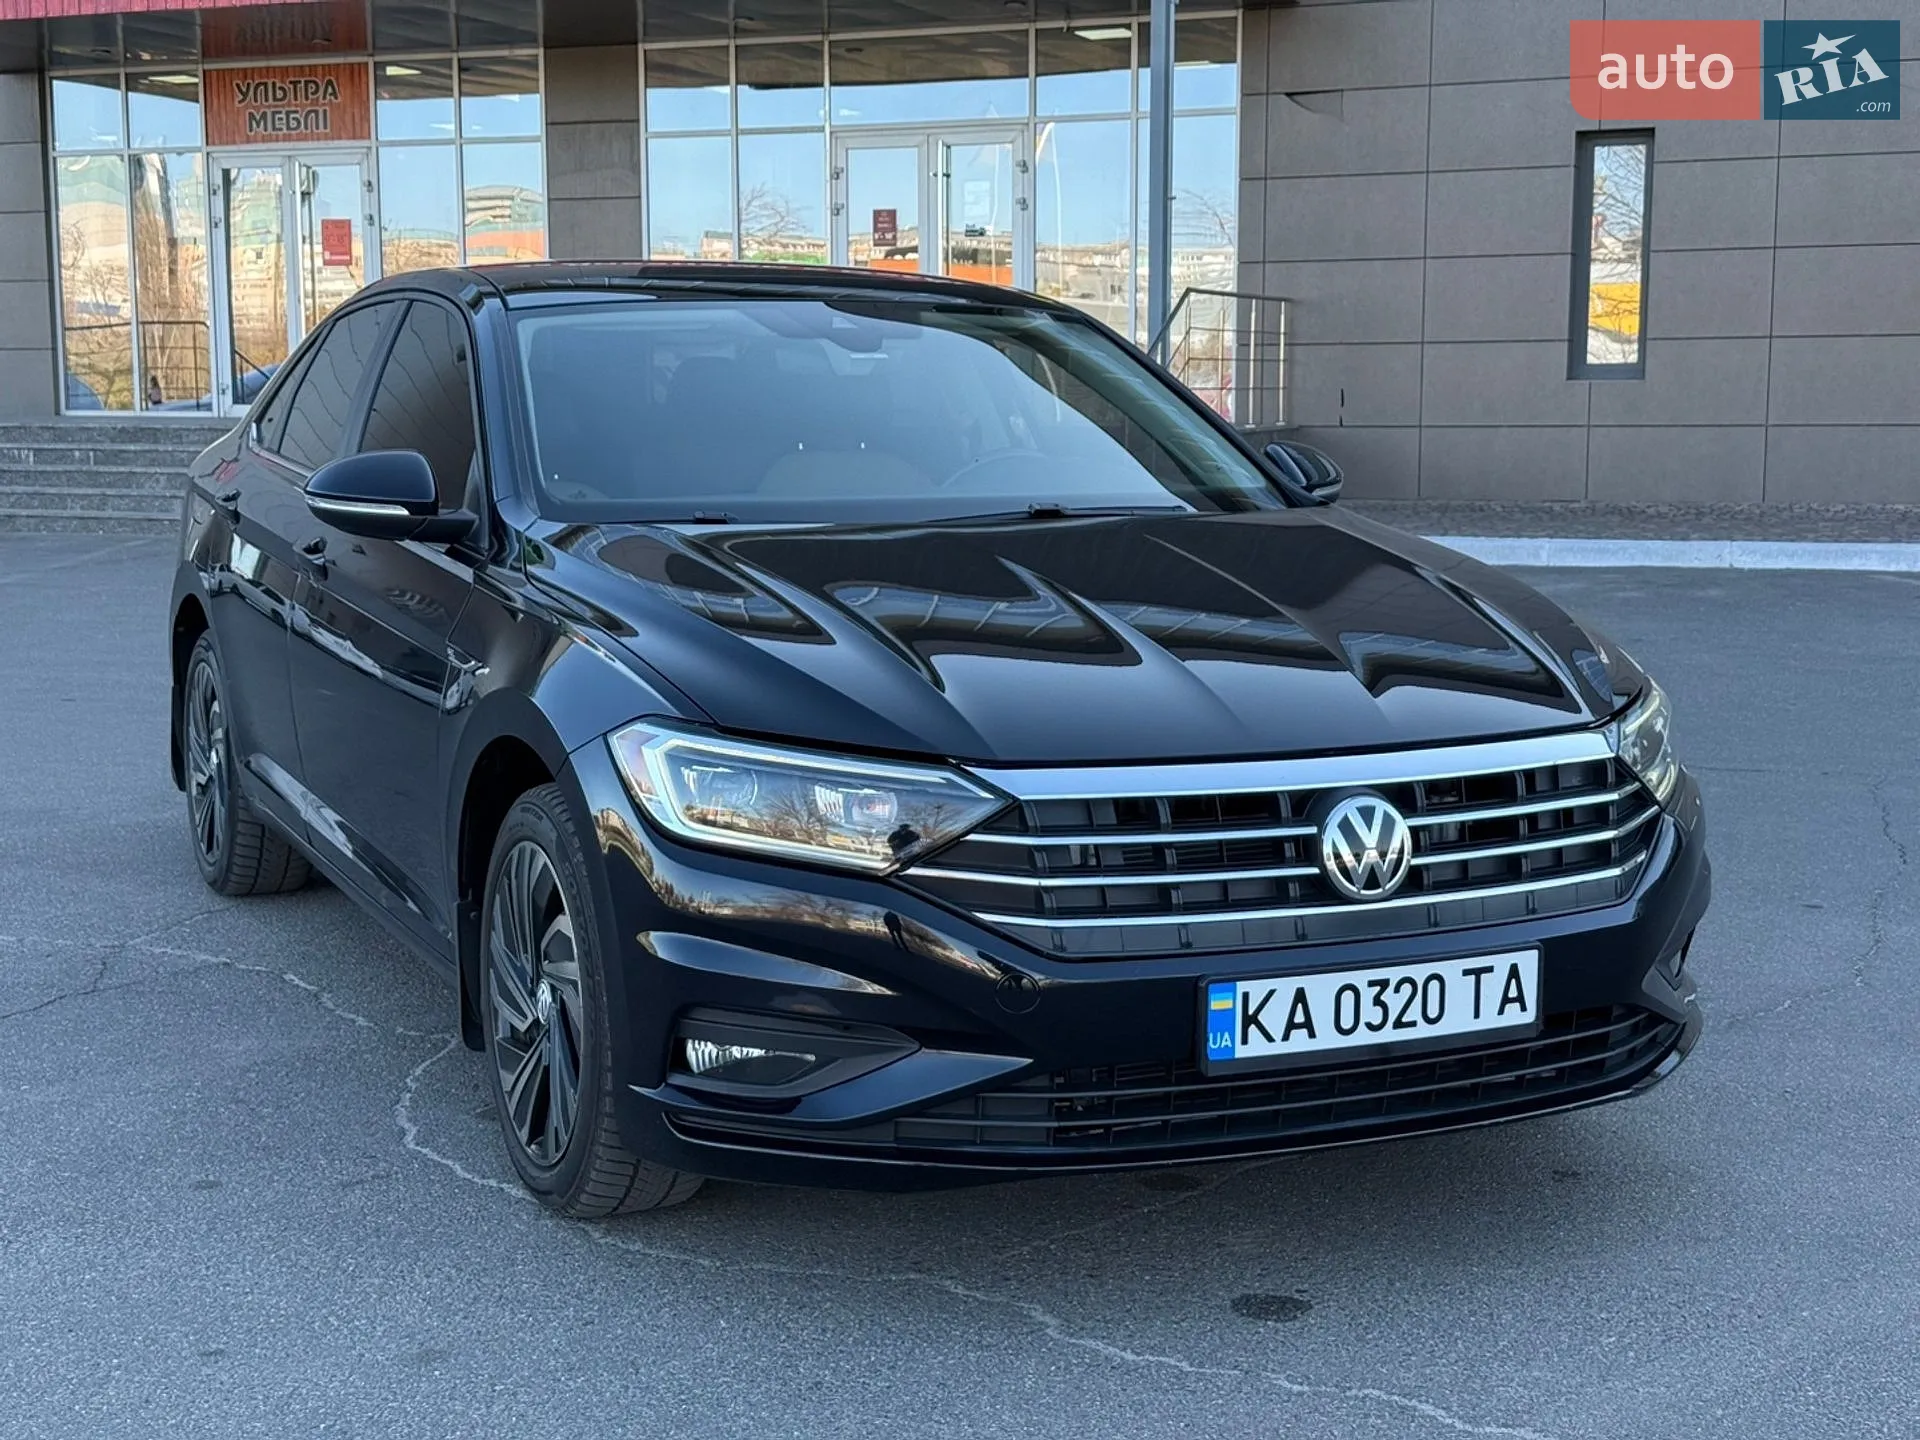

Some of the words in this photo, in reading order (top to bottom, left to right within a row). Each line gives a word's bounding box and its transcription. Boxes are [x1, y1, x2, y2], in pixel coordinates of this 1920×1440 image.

[234, 78, 339, 105] УЛЬТРА
[247, 108, 330, 134] МЕБЛІ
[1240, 986, 1317, 1046] KA
[1334, 973, 1446, 1036] 0320
[1461, 963, 1528, 1020] TA
[1209, 1032, 1233, 1049] UA
